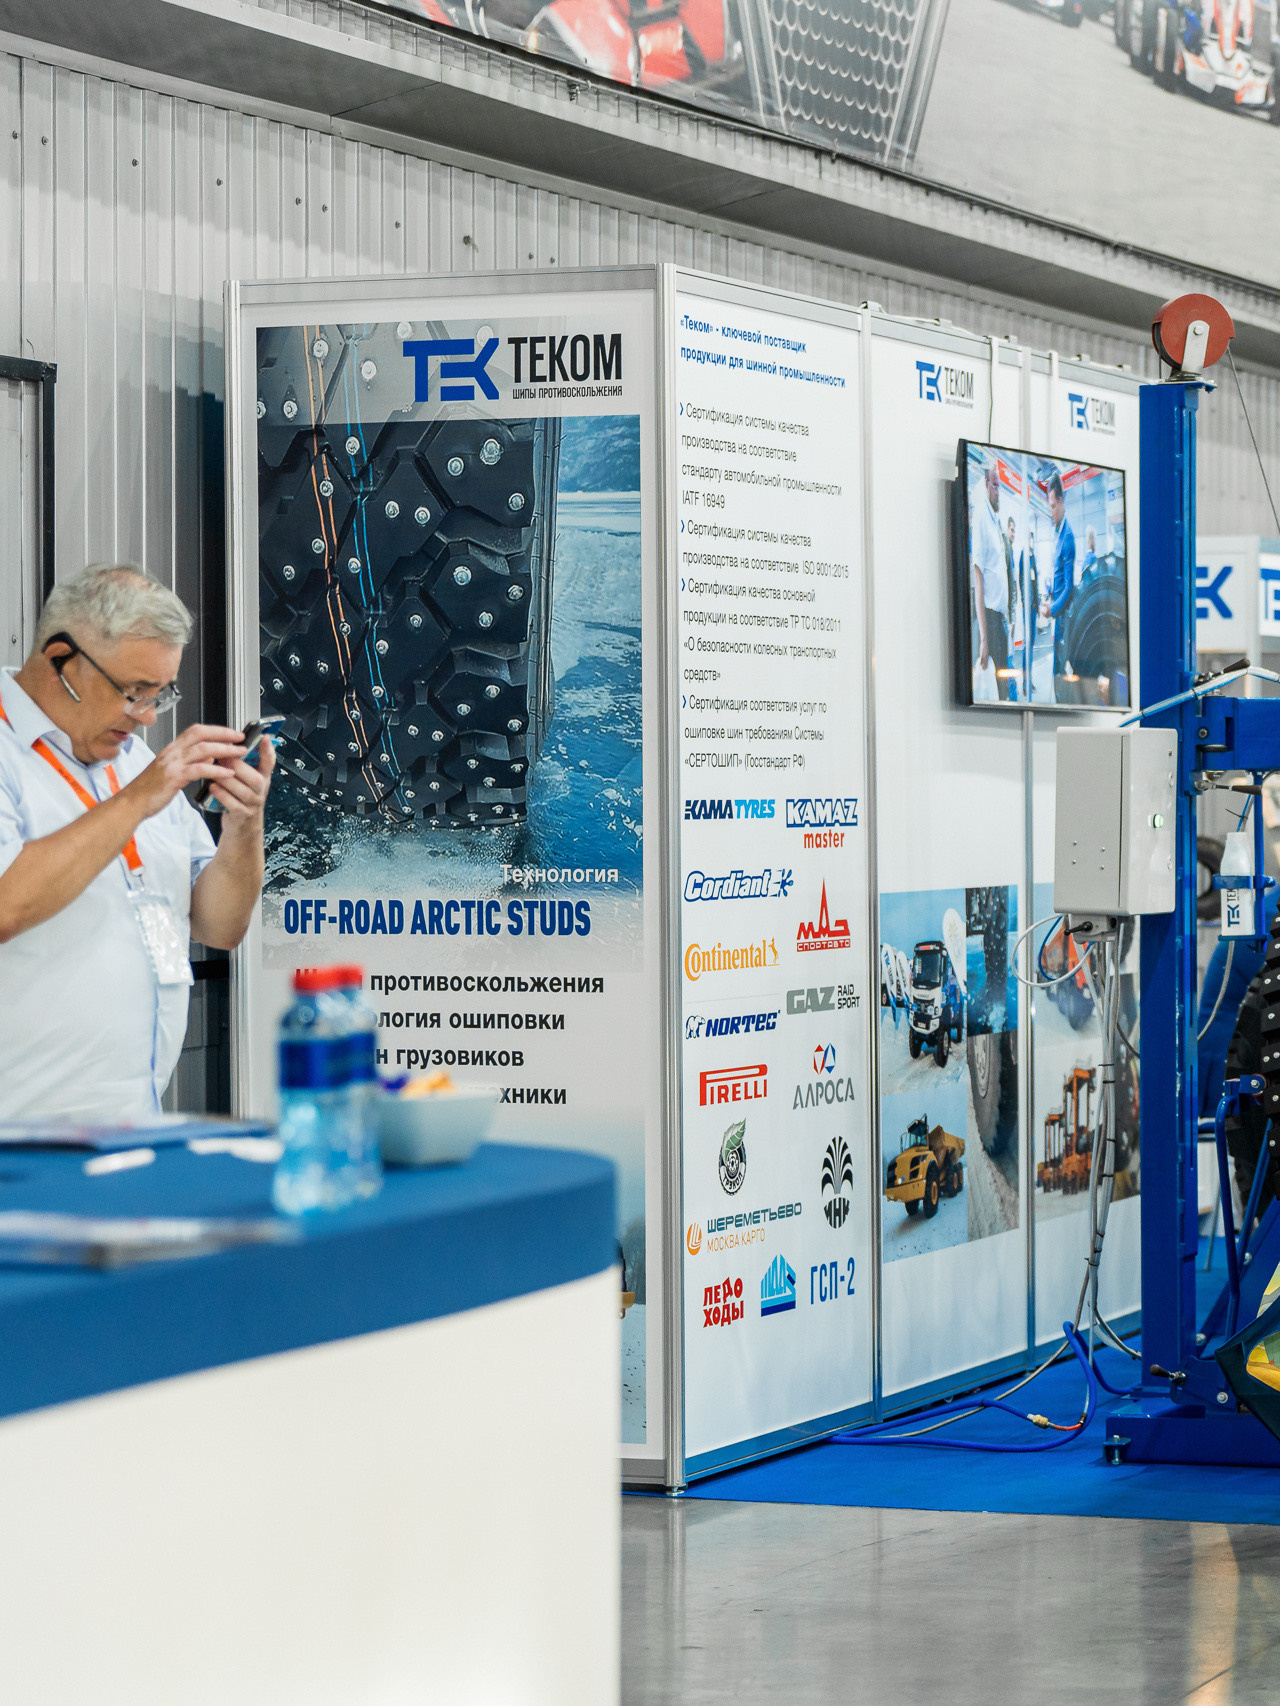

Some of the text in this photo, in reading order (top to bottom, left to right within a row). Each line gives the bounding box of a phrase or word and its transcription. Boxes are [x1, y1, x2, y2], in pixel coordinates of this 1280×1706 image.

[721, 325, 762, 345] ключевой
[764, 334, 807, 354] поставщик
[508, 333, 622, 383] ТЕКОМ
[680, 346, 846, 388] продукции для шинной промышленности
[512, 385, 623, 400] ШИПЫ ПРОТИВОСКОЛЬЖЕНИЯ
[686, 402, 810, 436] Сертификация системы качества
[681, 434, 797, 462] производства на соответствие
[681, 463, 842, 496] стандарту автомобильной промышленности
[682, 489, 725, 509] IATF 16949
[687, 519, 812, 547] Сертификация системы качества
[682, 551, 849, 579] производства на соответствие ISO 9001:2015
[688, 578, 816, 603] Сертификация качества основной
[683, 609, 841, 632] продукции на соответствие ТР ТС 018/2011
[697, 637, 752, 655] безопасности
[753, 643, 788, 657] колесных
[789, 645, 837, 661] транспортных
[683, 668, 721, 684] средств»
[689, 694, 827, 716] Сертификация соответствия услуг по
[684, 725, 825, 743] ошиповке шин требованиям Системы
[685, 752, 806, 772] «СЕРТОШИП» (Госстандарт РФ)
[734, 798, 776, 819] TYRES
[786, 798, 858, 828] KAMAZ
[803, 829, 845, 849] master
[500, 864, 620, 884] Технология
[684, 869, 773, 902] Cordiant
[284, 899, 592, 936] OFF-ROAD ARCTIC STUDS
[797, 939, 851, 952] СПОРТАВТО
[684, 939, 768, 981] Continental
[370, 971, 605, 996] противоскольжения
[837, 984, 855, 997] RAID
[786, 986, 836, 1015] GAZ
[837, 996, 861, 1010] SPORT
[448, 1013, 566, 1031] ошиповки
[396, 1048, 525, 1070] грузовиков
[699, 1064, 768, 1106] PIRELLI
[793, 1077, 855, 1110] АЛРОСА
[707, 1202, 803, 1234] ШЕРЕМЕТЬЕВО
[706, 1228, 766, 1254] МОСКВА КАРГО
[703, 1276, 743, 1306] ЛЕДО
[810, 1257, 856, 1305] ГСП-2
[703, 1300, 744, 1328] ХОДЫ
